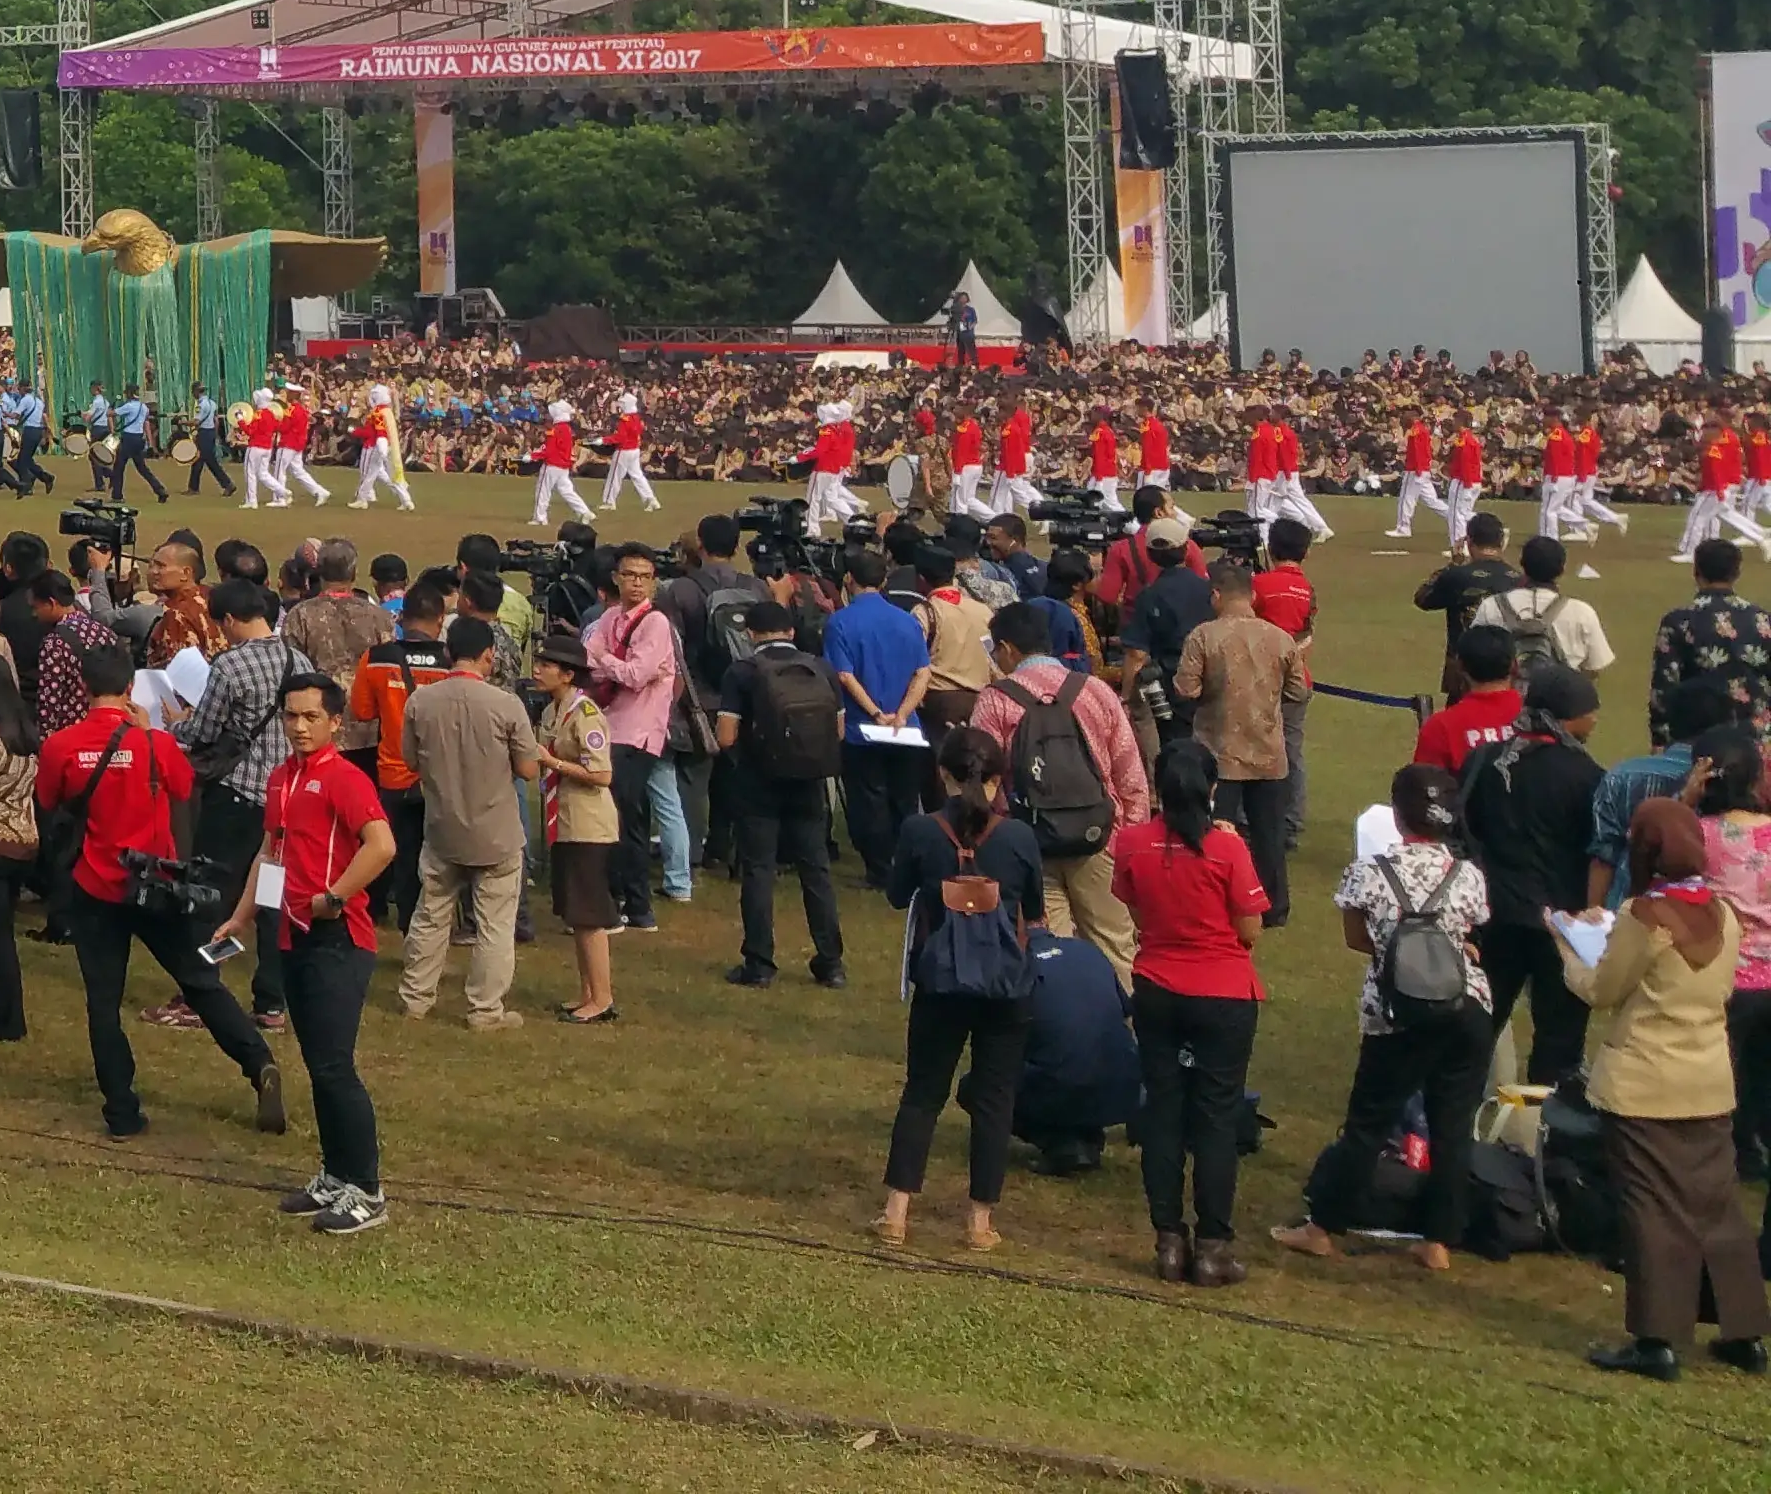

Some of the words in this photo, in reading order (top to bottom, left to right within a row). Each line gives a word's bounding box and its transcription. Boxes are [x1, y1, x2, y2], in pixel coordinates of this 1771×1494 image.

[371, 46, 416, 57] PENTAS
[444, 44, 492, 54] BUDAYA
[551, 41, 577, 52] AND
[578, 40, 603, 51] ART
[339, 56, 462, 78] RAIMUNA
[471, 52, 607, 75] NASIONAL
[616, 51, 644, 71] XI
[649, 49, 702, 70] 2017
[1467, 725, 1515, 748] PRE
